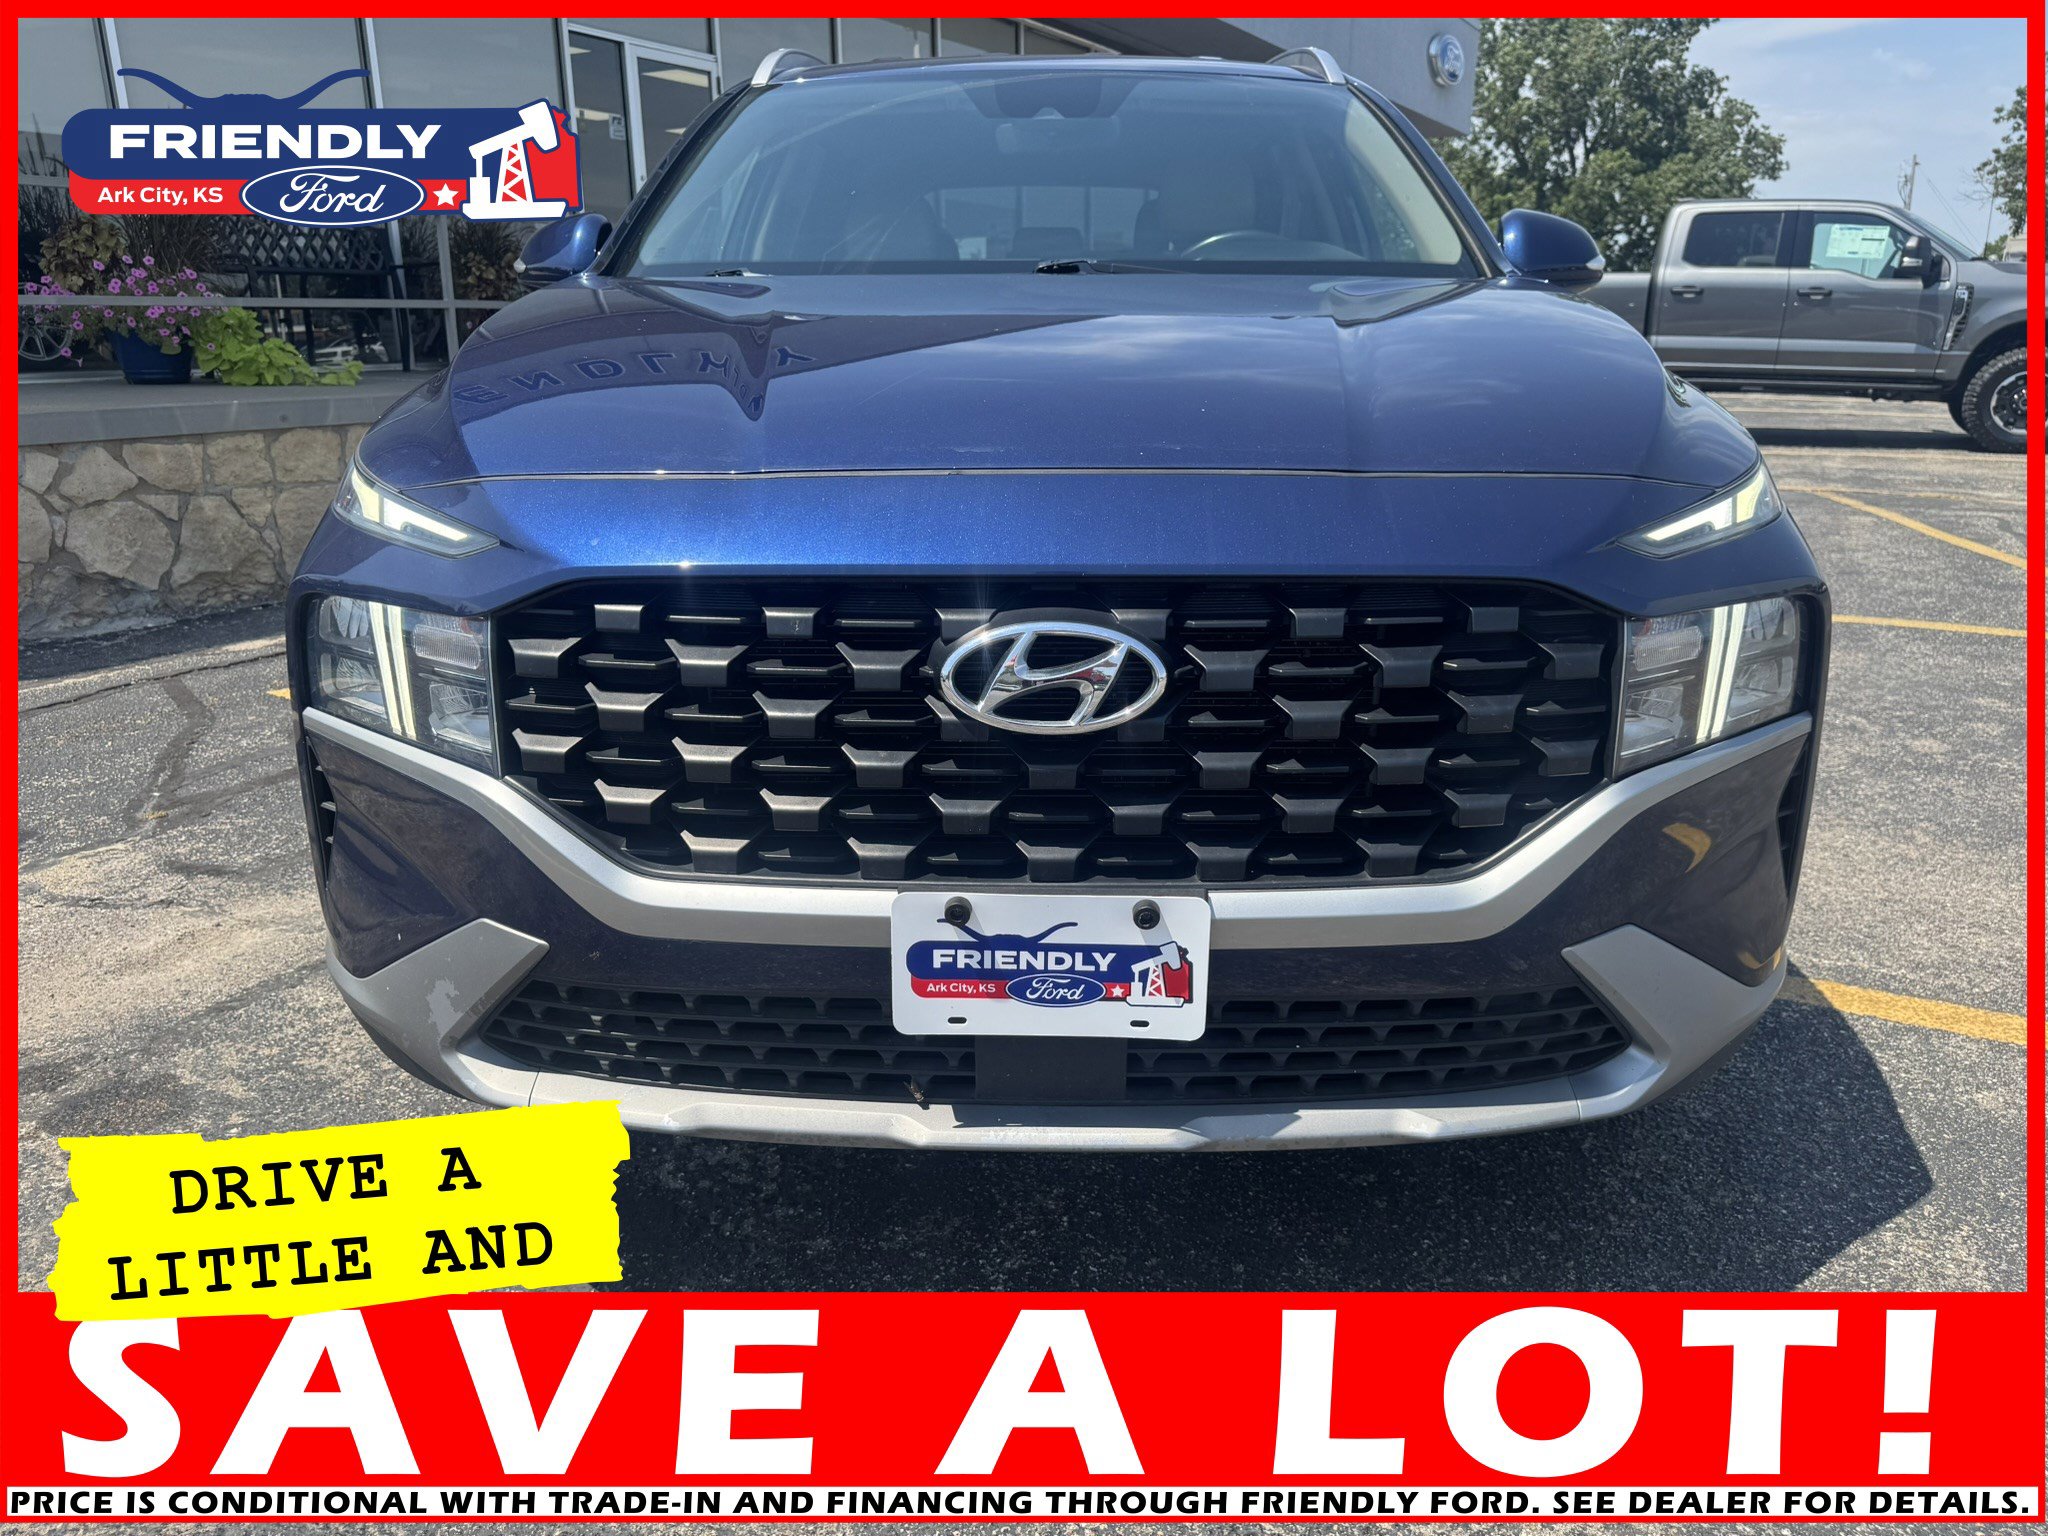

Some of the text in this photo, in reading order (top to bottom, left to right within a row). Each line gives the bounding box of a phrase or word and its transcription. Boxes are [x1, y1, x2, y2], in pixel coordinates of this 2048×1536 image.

[932, 949, 1117, 972] FRIENDLY
[926, 982, 996, 994] Ark City, KS
[1025, 976, 1084, 1001] Ford
